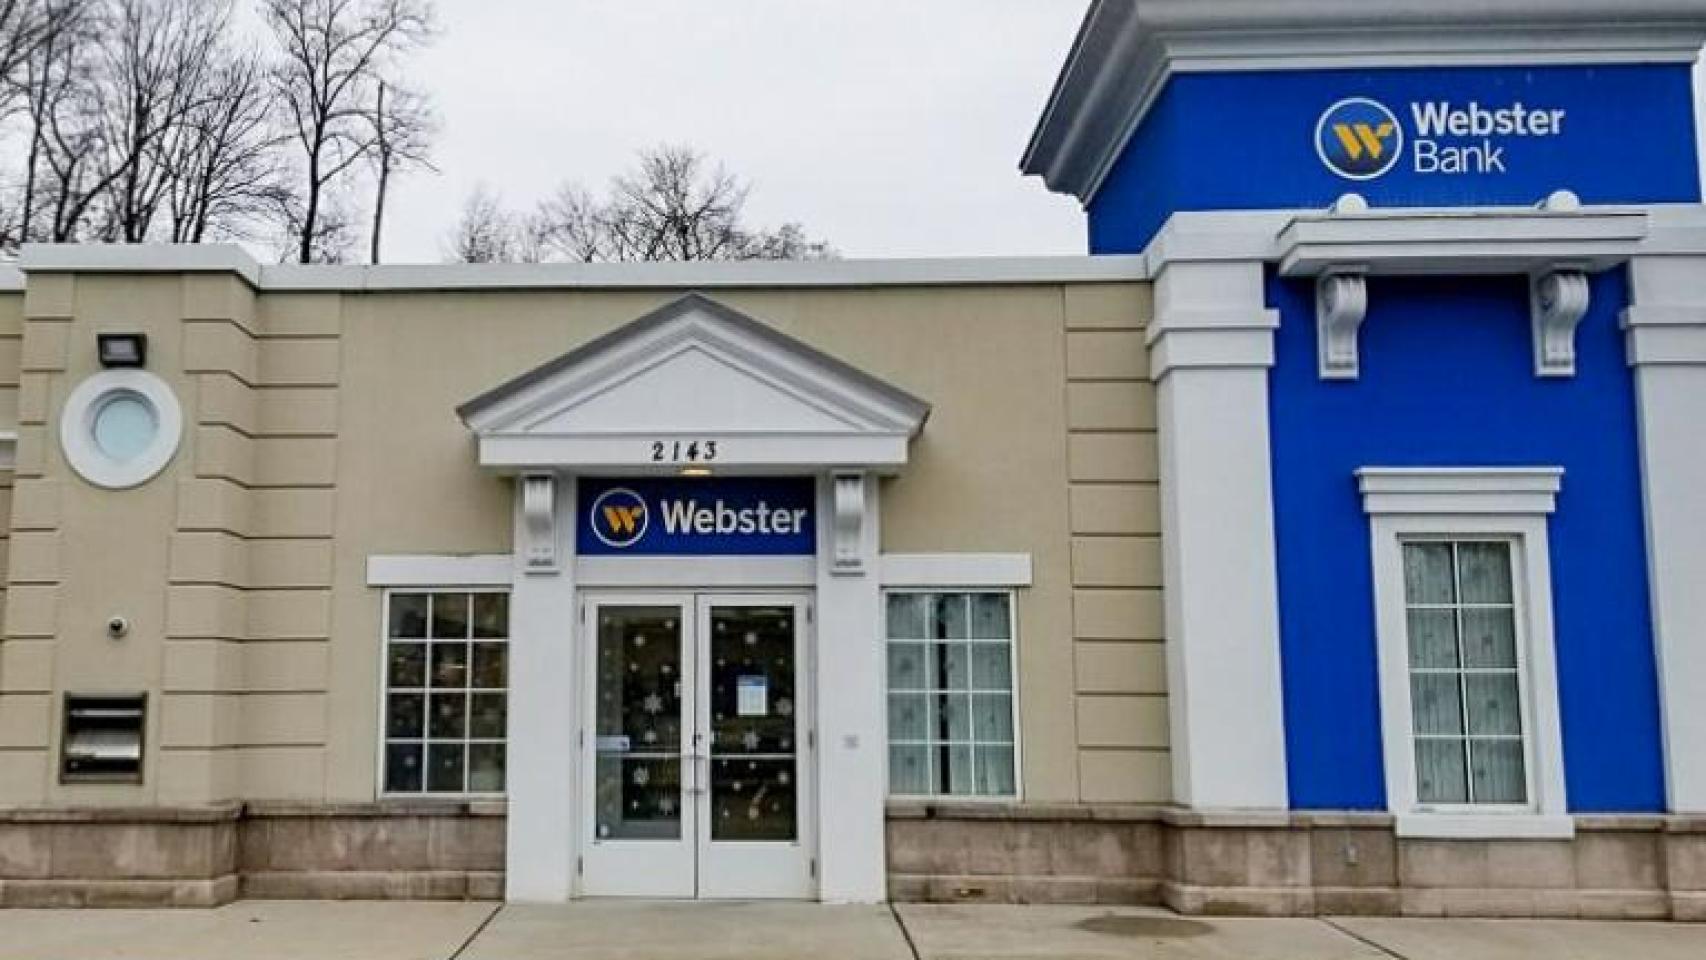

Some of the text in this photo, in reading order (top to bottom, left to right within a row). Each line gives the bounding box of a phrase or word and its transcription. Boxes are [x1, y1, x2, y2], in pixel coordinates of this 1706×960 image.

[1410, 101, 1566, 136] Webster
[1413, 138, 1507, 173] Bank
[652, 440, 717, 462] 2143
[660, 499, 808, 535] Webster
